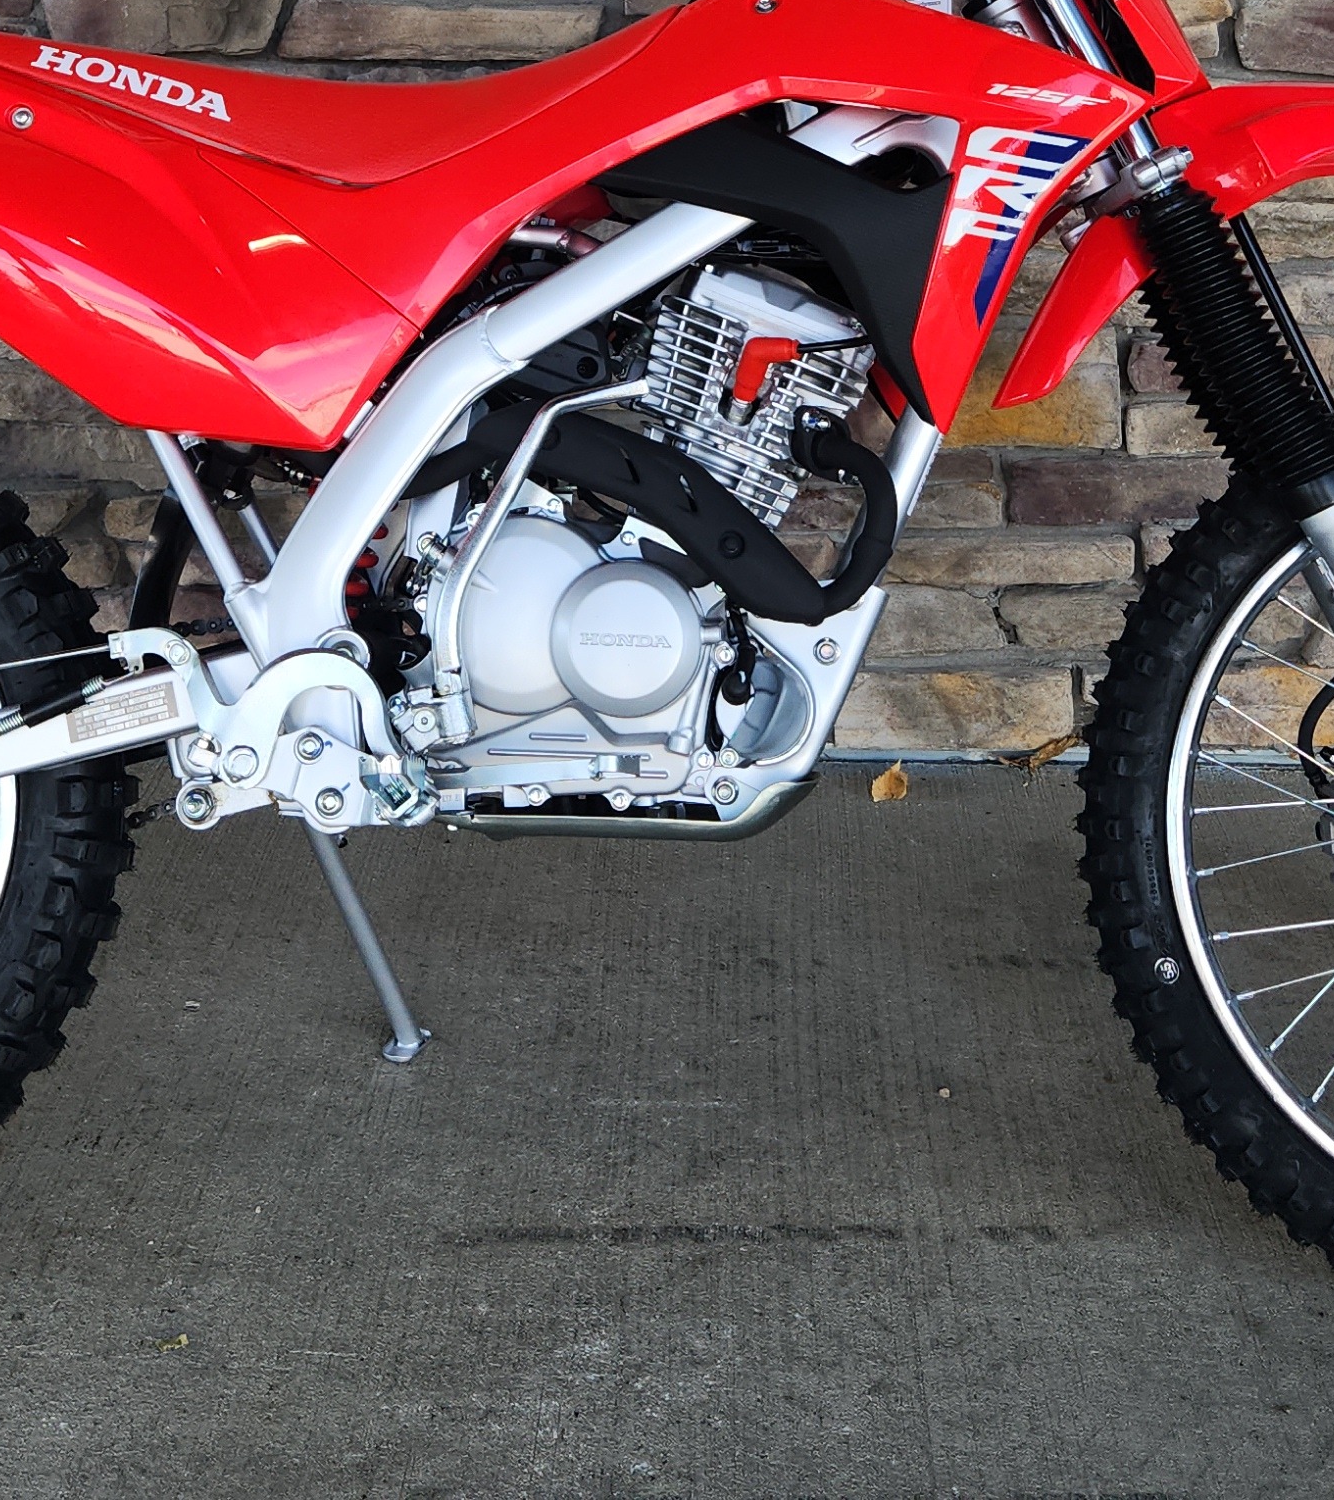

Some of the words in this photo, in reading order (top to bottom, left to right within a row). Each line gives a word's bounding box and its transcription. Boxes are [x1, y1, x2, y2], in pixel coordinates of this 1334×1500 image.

[31, 45, 231, 122] HONDA
[986, 82, 1111, 108] 125F
[943, 125, 1080, 246] CRF
[579, 632, 672, 649] HONDA
